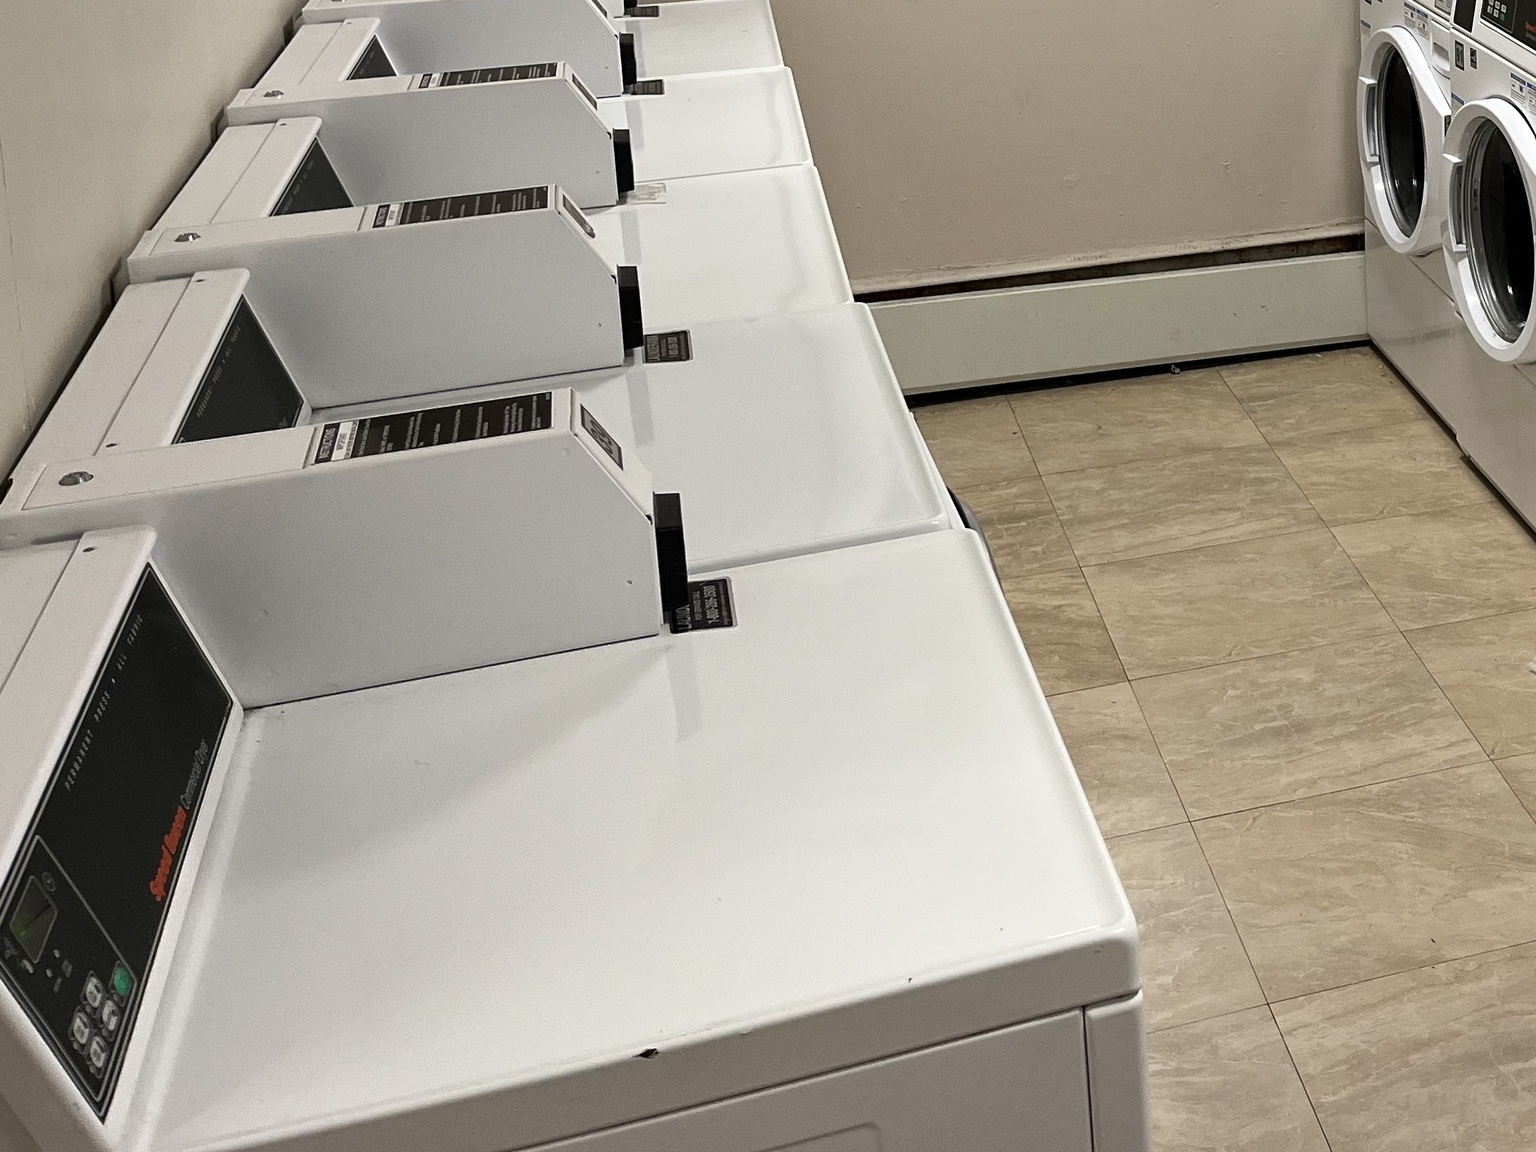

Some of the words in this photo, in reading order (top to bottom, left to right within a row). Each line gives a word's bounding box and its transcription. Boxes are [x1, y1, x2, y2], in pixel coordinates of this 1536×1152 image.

[94, 690, 111, 722] PRESS
[116, 653, 128, 671] ALL
[127, 614, 144, 646] FABRIC
[150, 844, 172, 902] Speed
[164, 805, 187, 854] Queen
